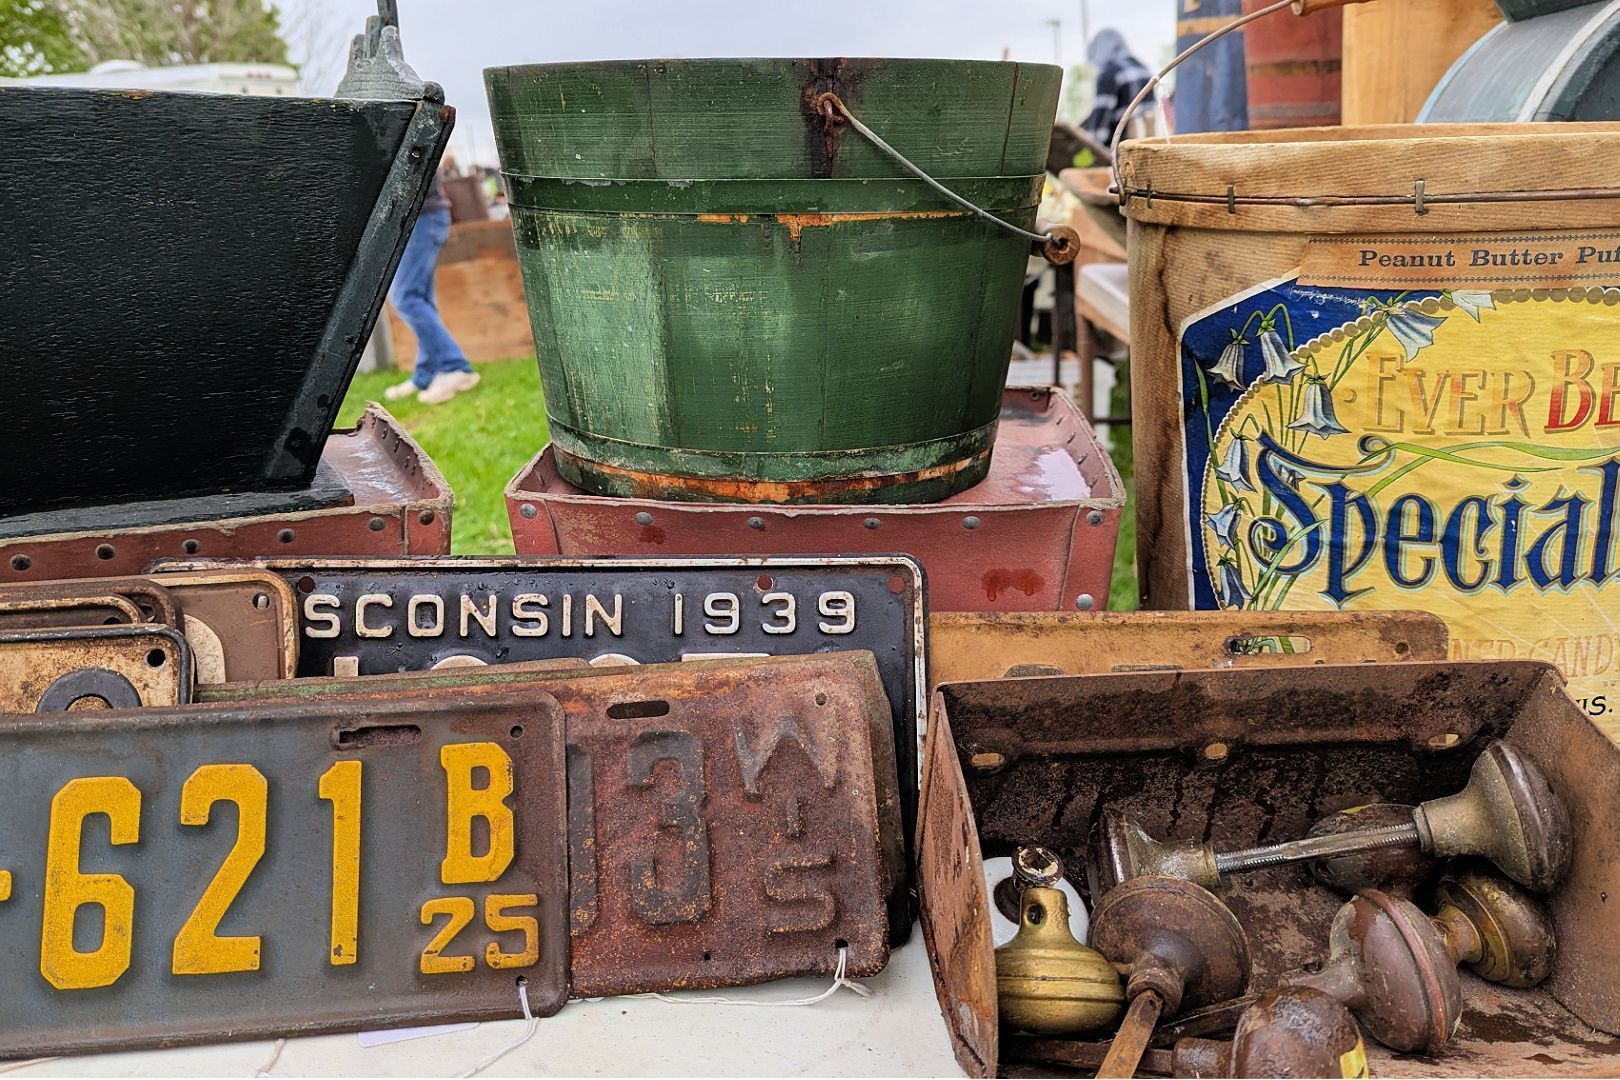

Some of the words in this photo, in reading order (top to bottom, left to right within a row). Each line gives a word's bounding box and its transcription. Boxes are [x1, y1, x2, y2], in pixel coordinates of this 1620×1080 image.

[1358, 249, 1456, 267] Peanut
[1469, 248, 1564, 267] Butter
[1362, 351, 1535, 438] EVER
[1248, 430, 1620, 609] Special
[303, 592, 623, 639] SCONSIN
[673, 590, 857, 636] 1939
[1528, 633, 1620, 679] CAND
[440, 741, 515, 885] B
[419, 893, 539, 975] 25
